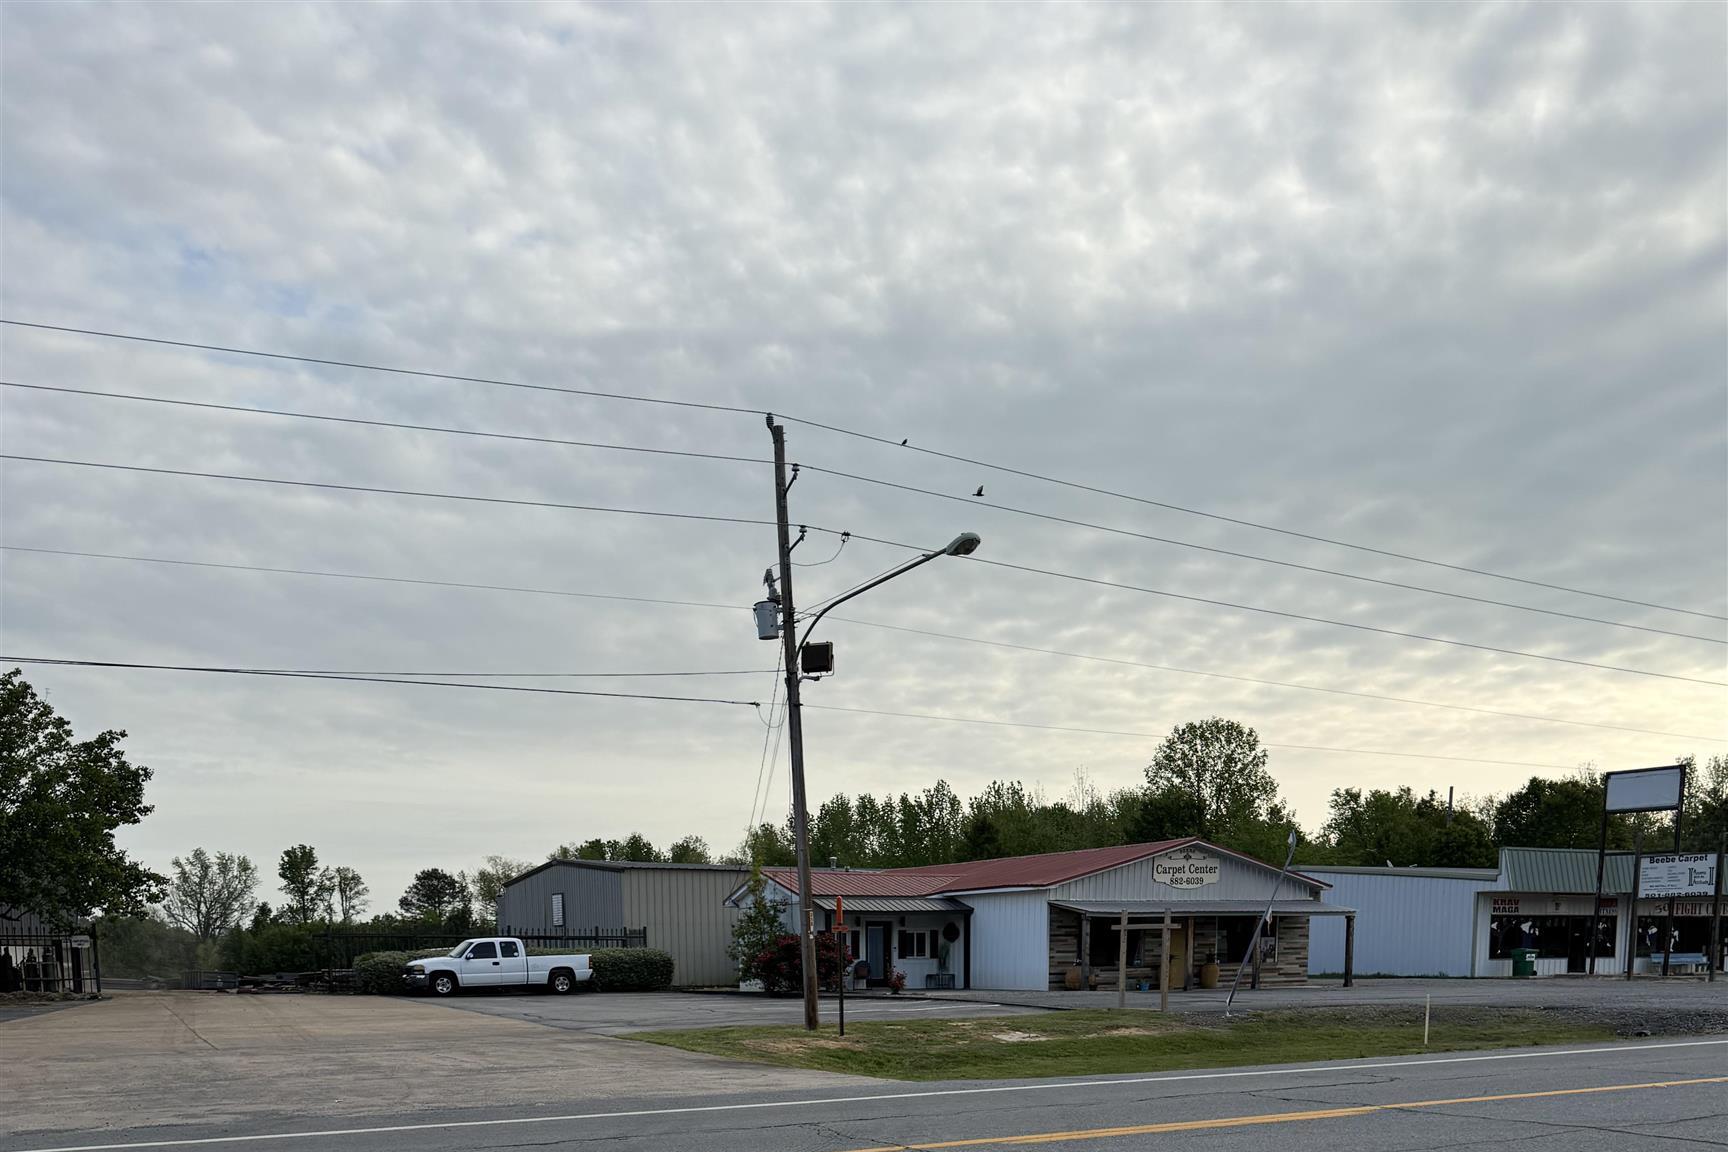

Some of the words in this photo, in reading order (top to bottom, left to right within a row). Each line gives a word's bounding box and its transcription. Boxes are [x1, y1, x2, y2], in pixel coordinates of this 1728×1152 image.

[1649, 856, 1676, 864] Beebe
[1679, 854, 1708, 863] Carpet
[1156, 864, 1186, 876] Carpet
[1188, 864, 1218, 874] Center
[1169, 877, 1204, 885] 882-6039
[1492, 898, 1520, 906] KRAV
[1675, 902, 1703, 915] FIGHT
